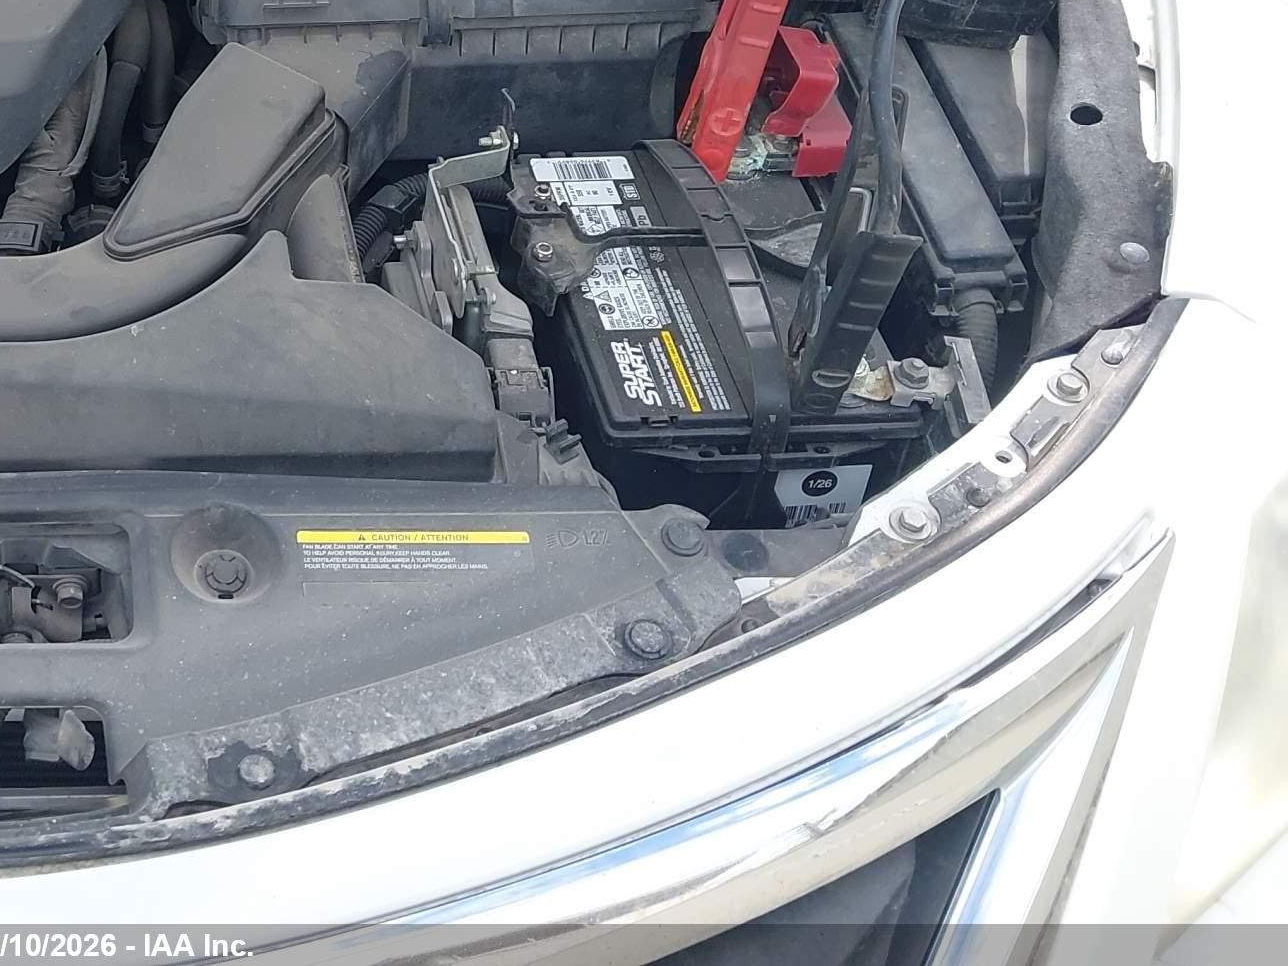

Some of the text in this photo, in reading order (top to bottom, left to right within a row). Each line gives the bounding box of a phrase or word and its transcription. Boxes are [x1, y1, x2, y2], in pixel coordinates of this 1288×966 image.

[636, 214, 650, 226] Pb
[610, 341, 639, 399] SUPER
[624, 341, 663, 407] START
[808, 479, 833, 489] 1/26
